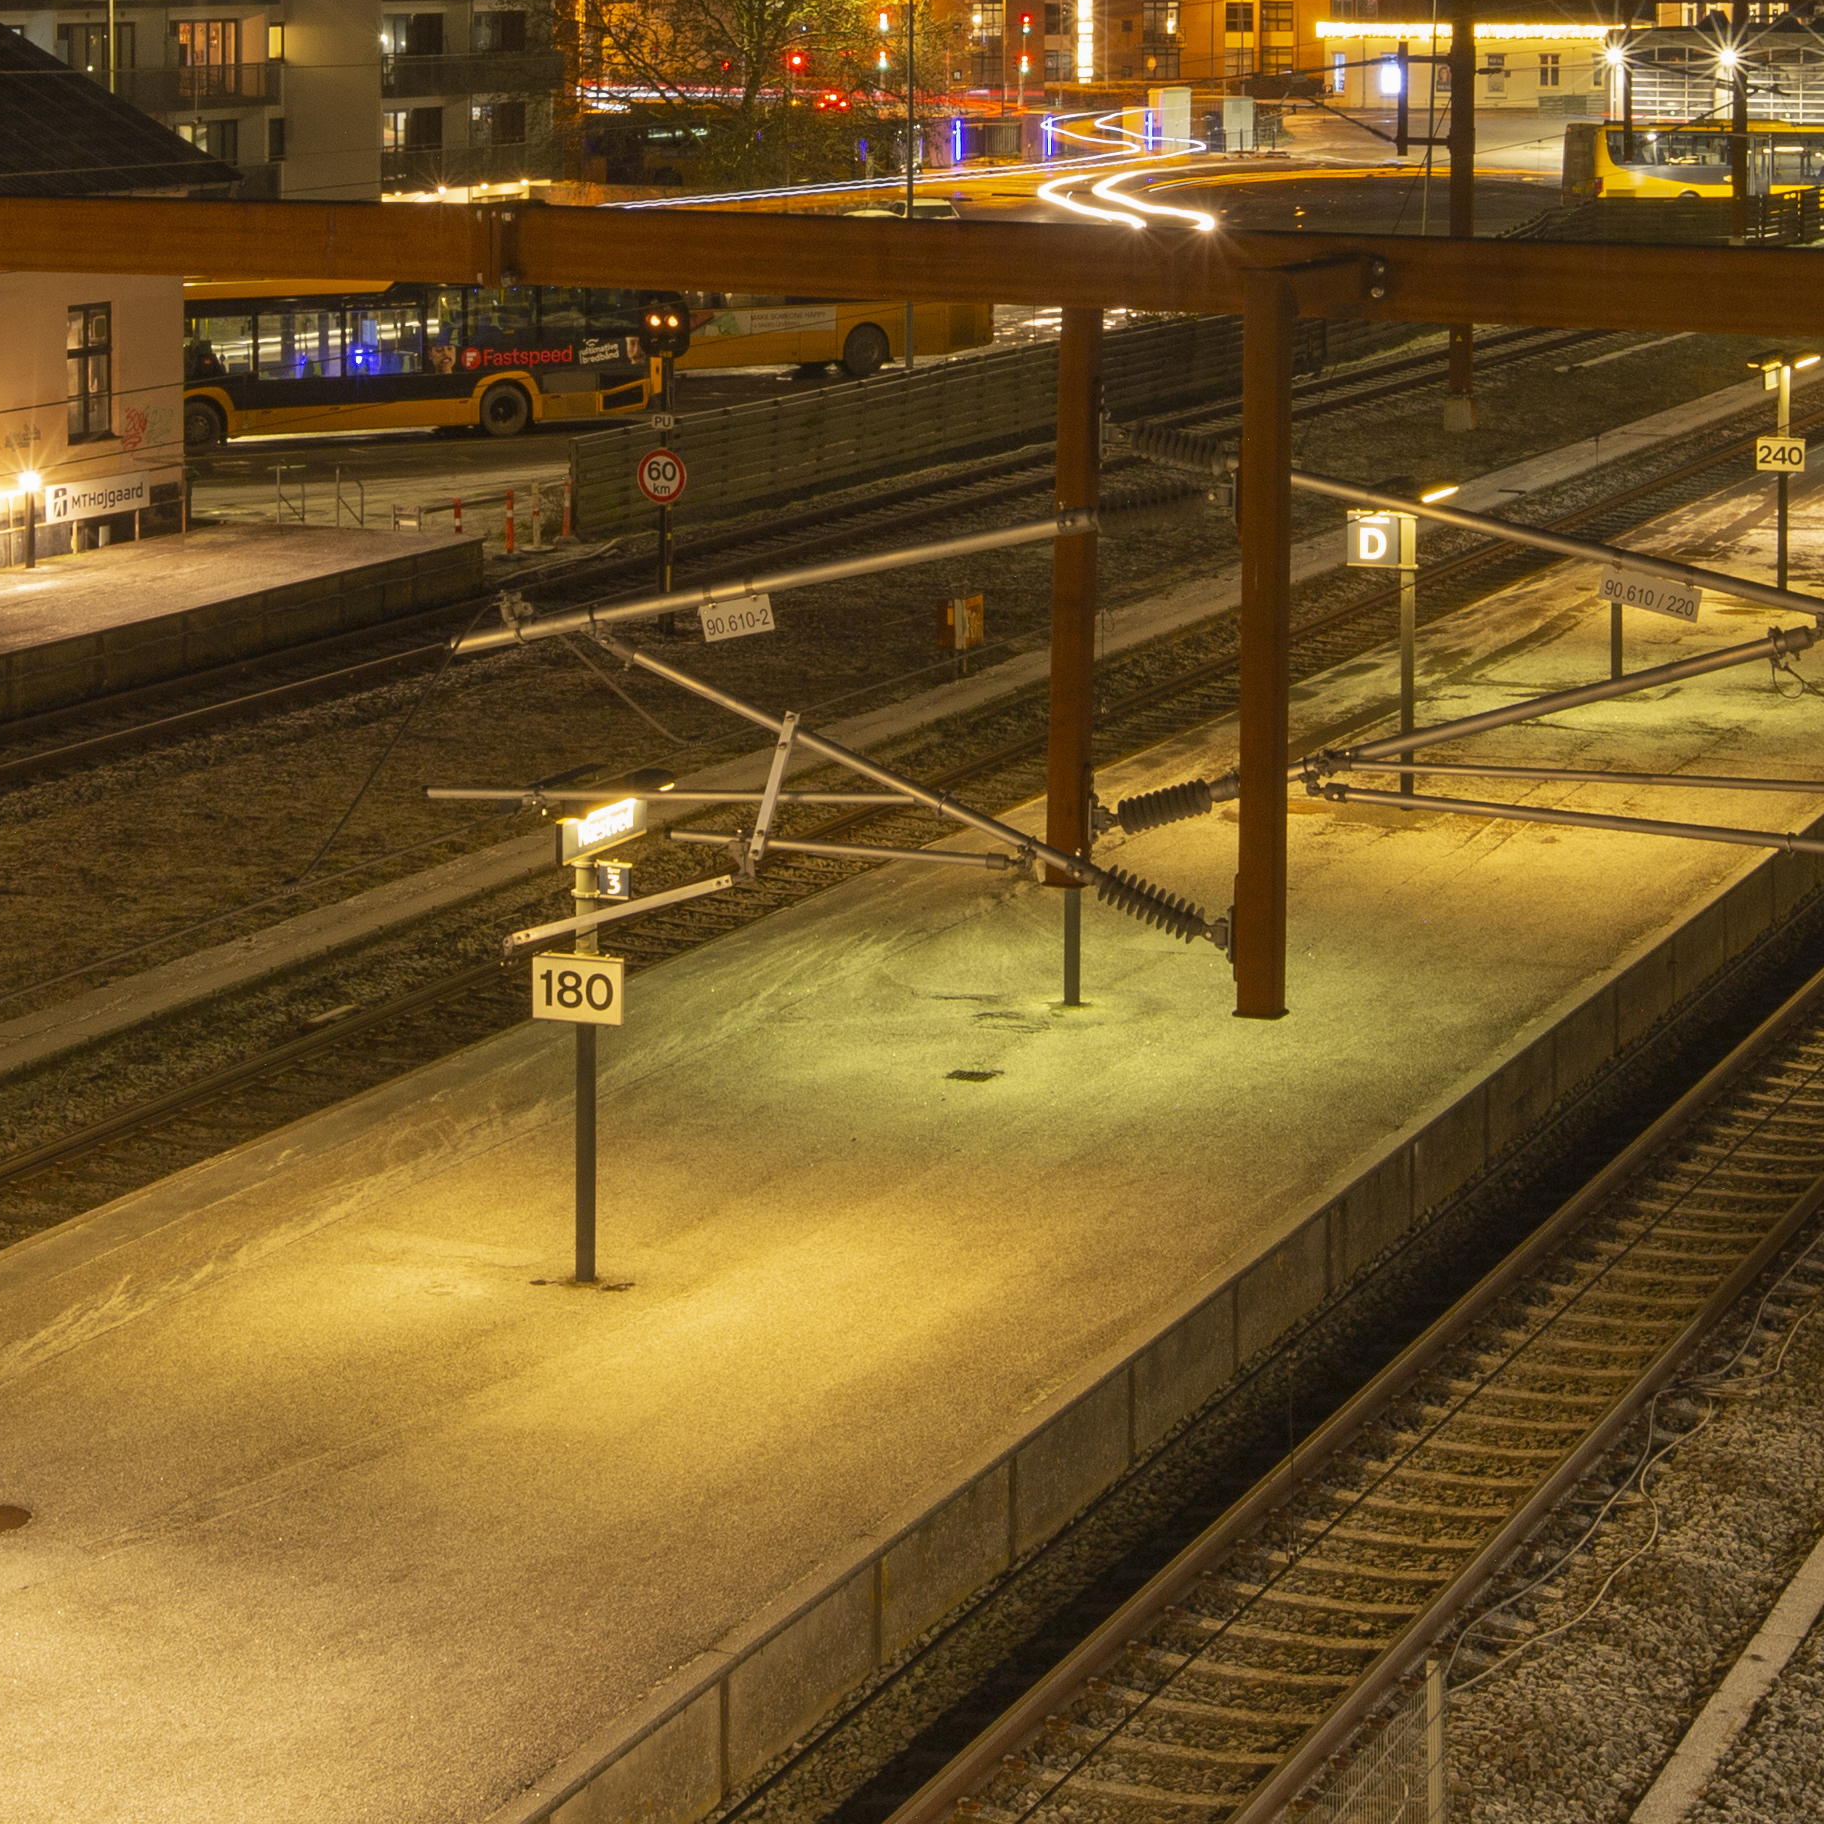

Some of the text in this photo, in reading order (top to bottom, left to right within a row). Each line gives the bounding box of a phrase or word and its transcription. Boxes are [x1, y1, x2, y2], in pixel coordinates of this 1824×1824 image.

[483, 344, 573, 368] Fastspeed
[654, 416, 671, 427] PU
[1758, 445, 1803, 466] 240
[647, 461, 677, 482] 60
[653, 483, 671, 494] km
[1359, 527, 1387, 559] D
[1604, 579, 1654, 606] 90.610
[1666, 595, 1694, 616] 220
[706, 608, 771, 636] 90.610-2
[606, 874, 621, 895] 3
[540, 969, 614, 1011] 180
